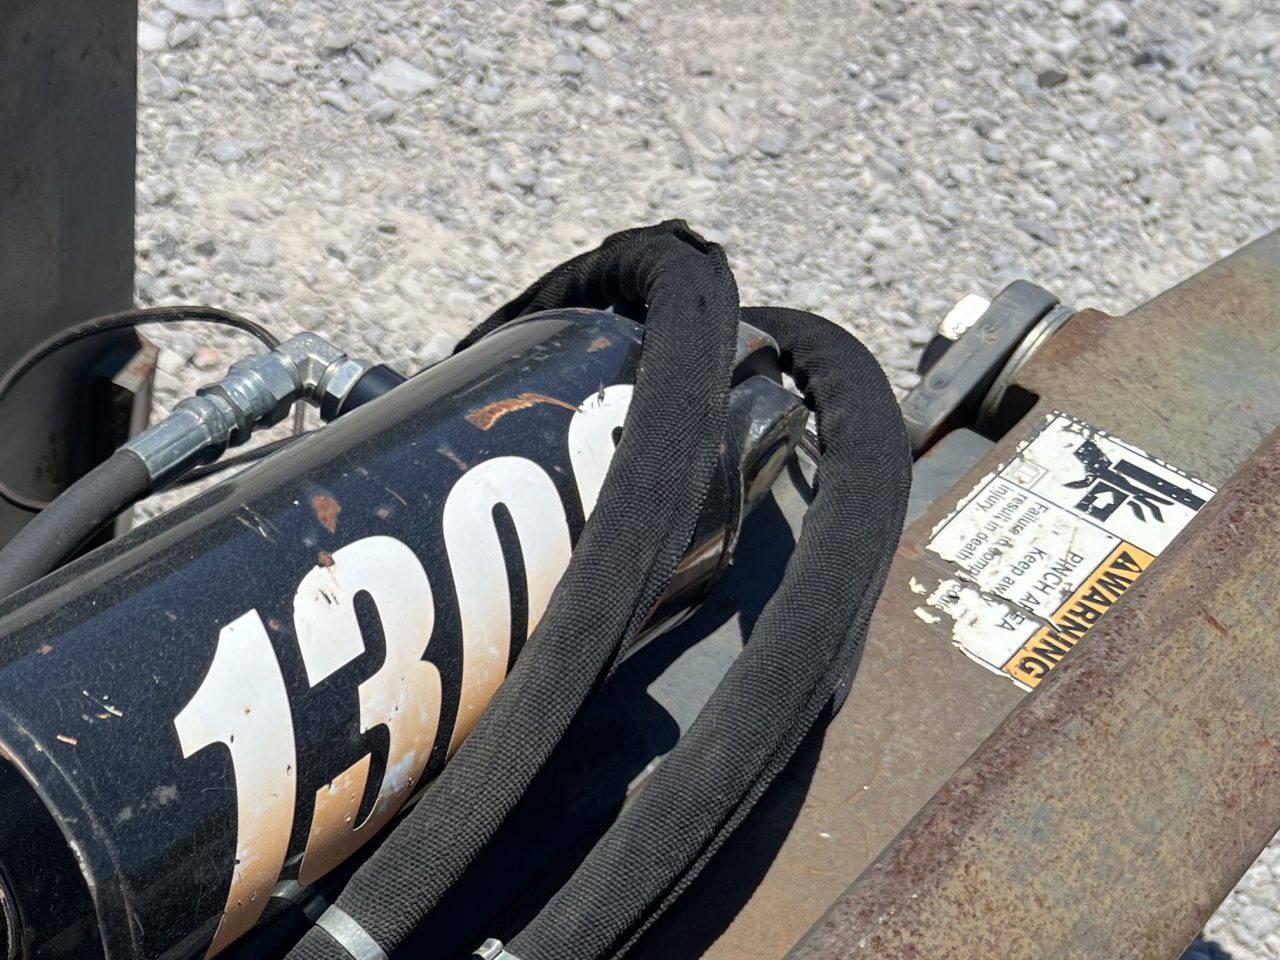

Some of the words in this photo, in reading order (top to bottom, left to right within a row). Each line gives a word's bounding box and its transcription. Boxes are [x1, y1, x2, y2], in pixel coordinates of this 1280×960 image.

[984, 520, 1000, 532] in
[955, 531, 989, 559] death
[1010, 546, 1046, 576] Keep
[957, 548, 999, 582] compl
[1034, 550, 1083, 595] PINCH
[1018, 569, 1132, 681] WARNING
